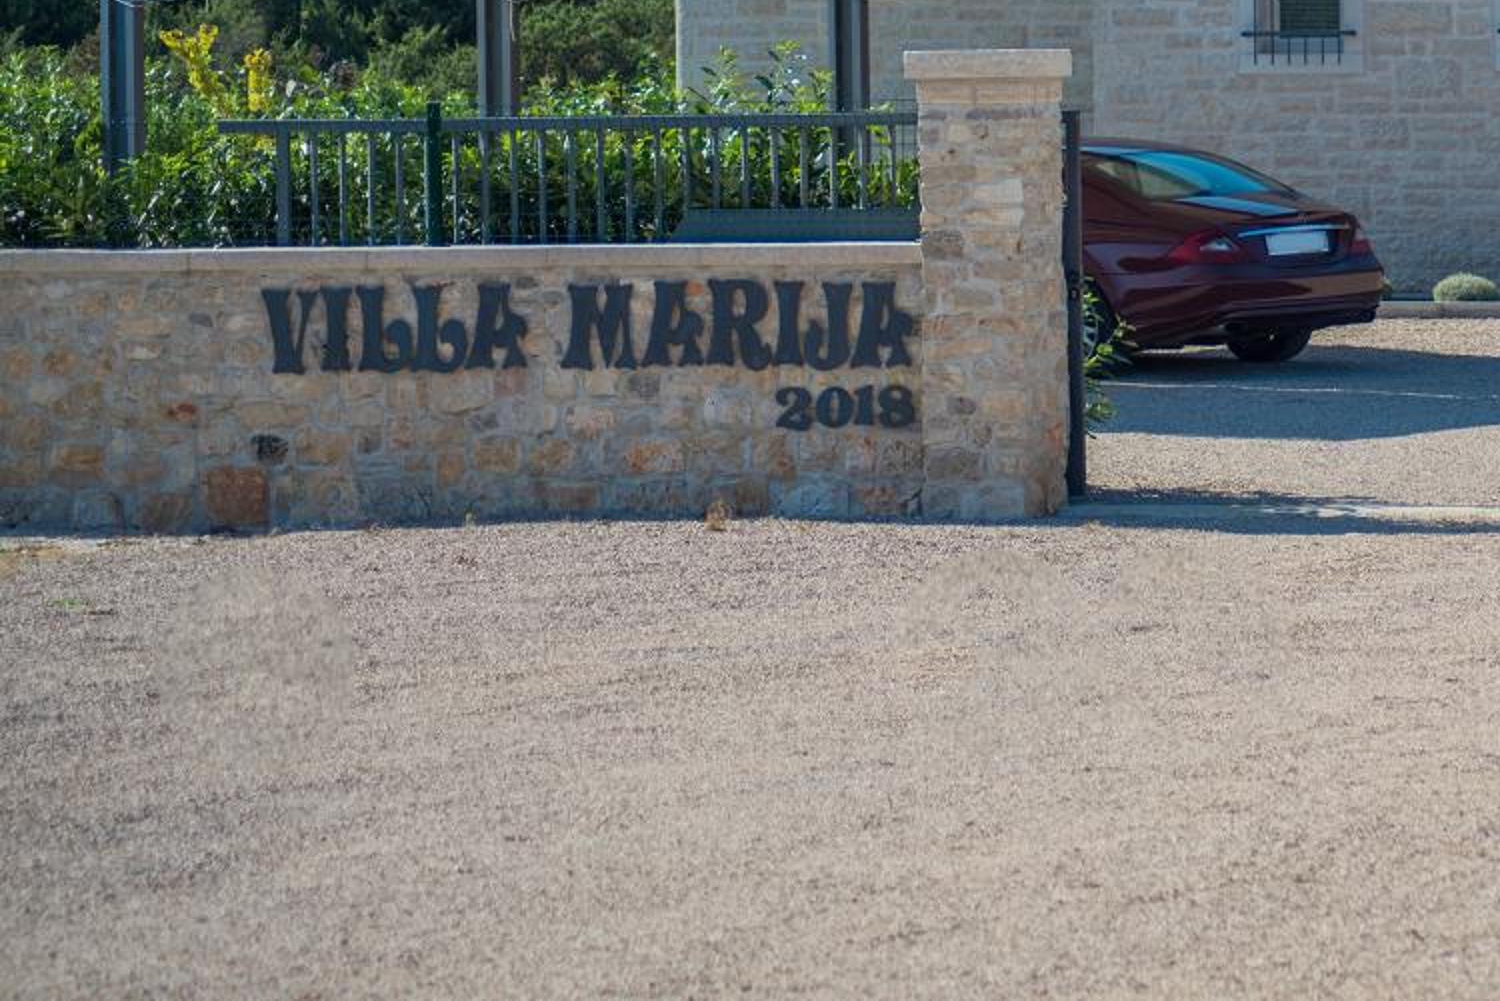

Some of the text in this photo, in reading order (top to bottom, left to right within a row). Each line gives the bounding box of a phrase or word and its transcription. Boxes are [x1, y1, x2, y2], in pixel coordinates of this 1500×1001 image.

[262, 278, 915, 375] VILLA MARIJA
[774, 384, 915, 432] 2018
